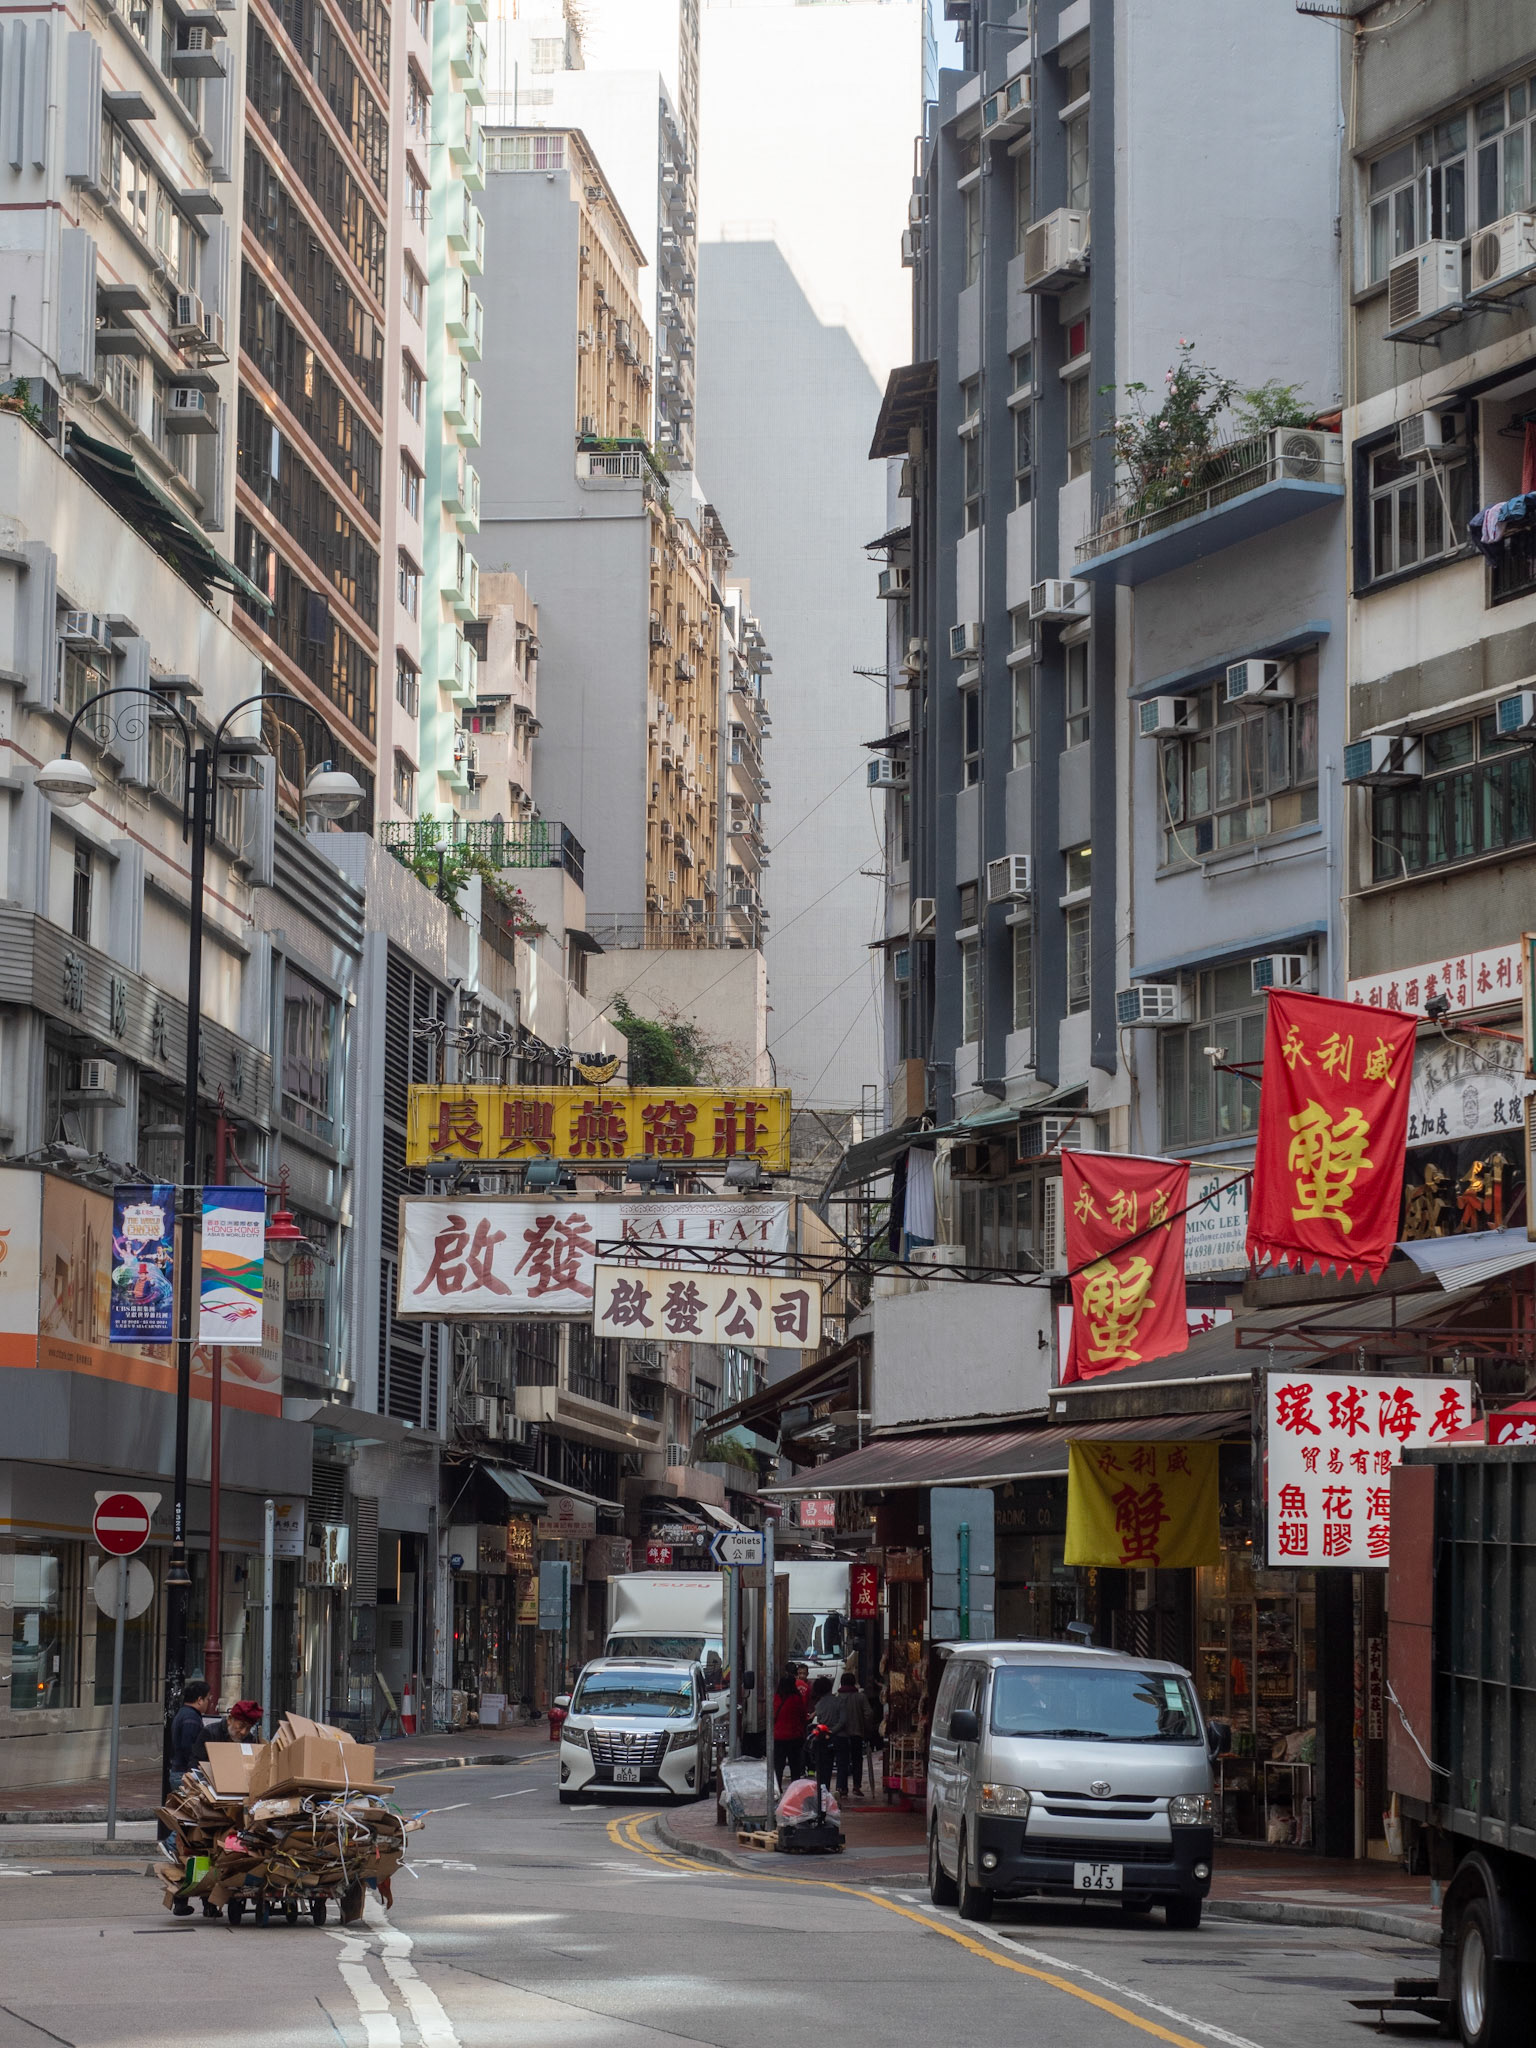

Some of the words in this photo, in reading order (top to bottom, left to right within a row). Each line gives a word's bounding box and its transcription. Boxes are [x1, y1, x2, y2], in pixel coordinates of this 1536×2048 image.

[1282, 1024, 1396, 1089] 永利威
[1288, 1098, 1374, 1234] 蟹
[1074, 1181, 1173, 1234] 永利威
[207, 1225, 233, 1233] HONG
[233, 1226, 260, 1234] KONG
[620, 1218, 688, 1241] KAI
[708, 1219, 775, 1241] FAT
[1186, 1219, 1215, 1234] MING
[1219, 1215, 1241, 1229] LEE
[1082, 1251, 1157, 1362] 蟹
[1097, 1445, 1192, 1478] 永利威
[1301, 1446, 1402, 1476] 貿易有限
[996, 1509, 1026, 1525] RADING
[1111, 1481, 1172, 1568] 蟹
[1278, 1484, 1309, 1557] 魚翅
[1322, 1485, 1353, 1557] 花膠
[731, 1536, 761, 1545] Toilets
[732, 1548, 756, 1560] 公廁
[856, 1568, 875, 1607] 永成
[616, 1773, 638, 1782] 8612
[621, 1767, 633, 1775] KA
[1082, 1875, 1114, 1890] 843
[1090, 1863, 1110, 1877] TF
